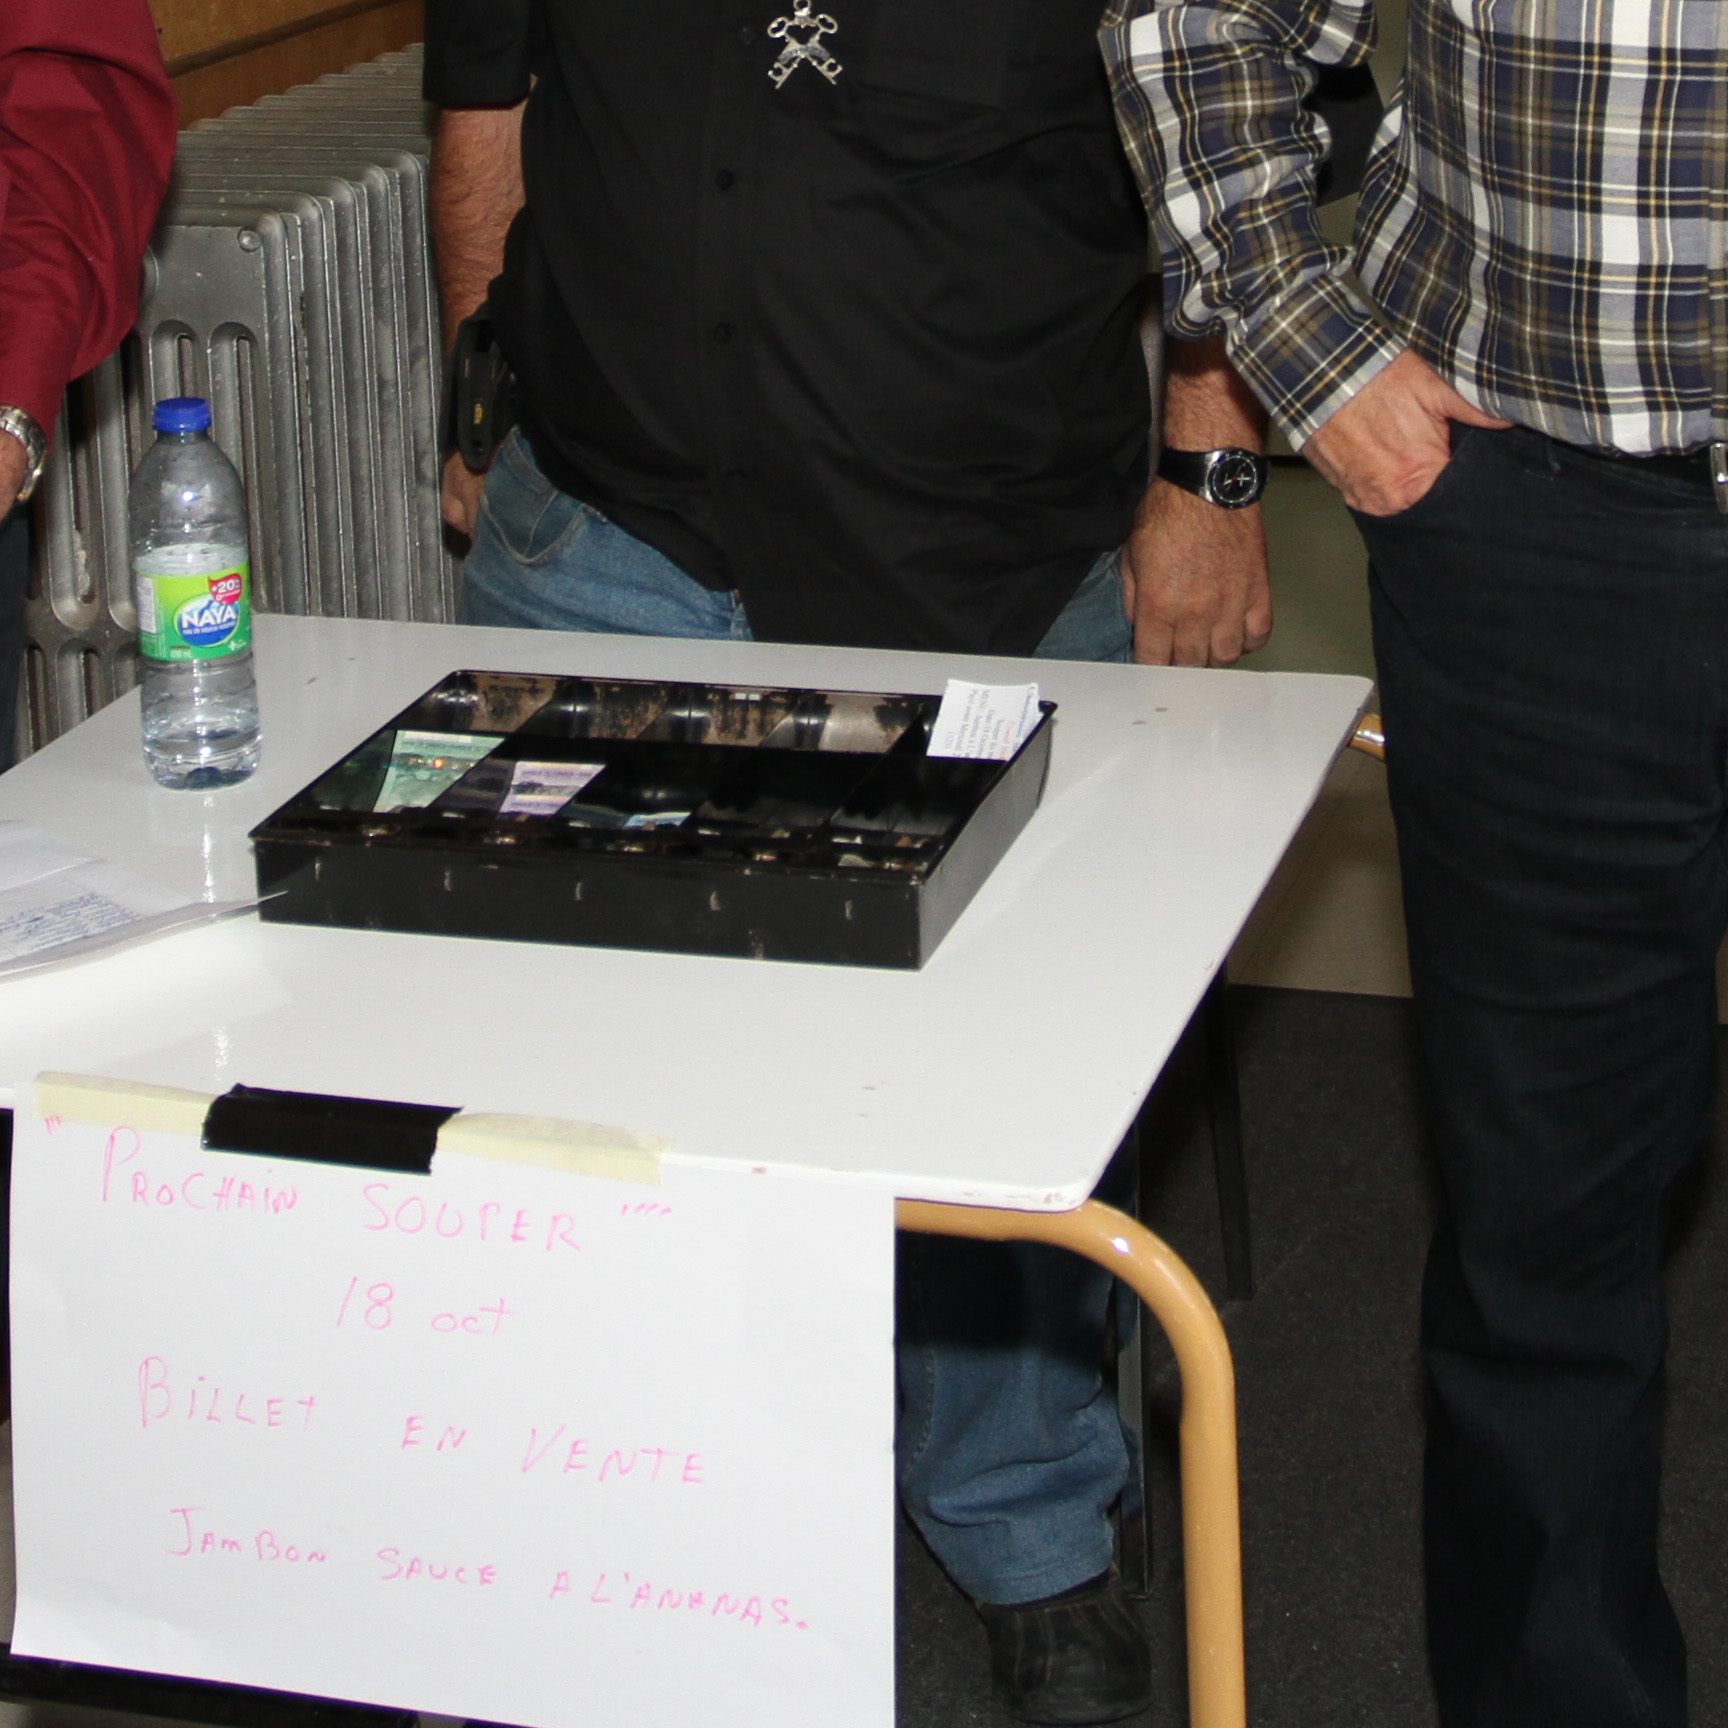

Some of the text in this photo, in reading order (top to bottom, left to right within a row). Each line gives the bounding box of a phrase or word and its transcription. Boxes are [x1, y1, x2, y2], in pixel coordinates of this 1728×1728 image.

[181, 604, 237, 629] NAYA
[360, 1181, 584, 1254] SOUPER
[335, 1276, 515, 1337] 18 oct
[401, 1414, 468, 1453] EN
[520, 1423, 707, 1487] VENTE
[377, 1546, 499, 1587] SAUCE
